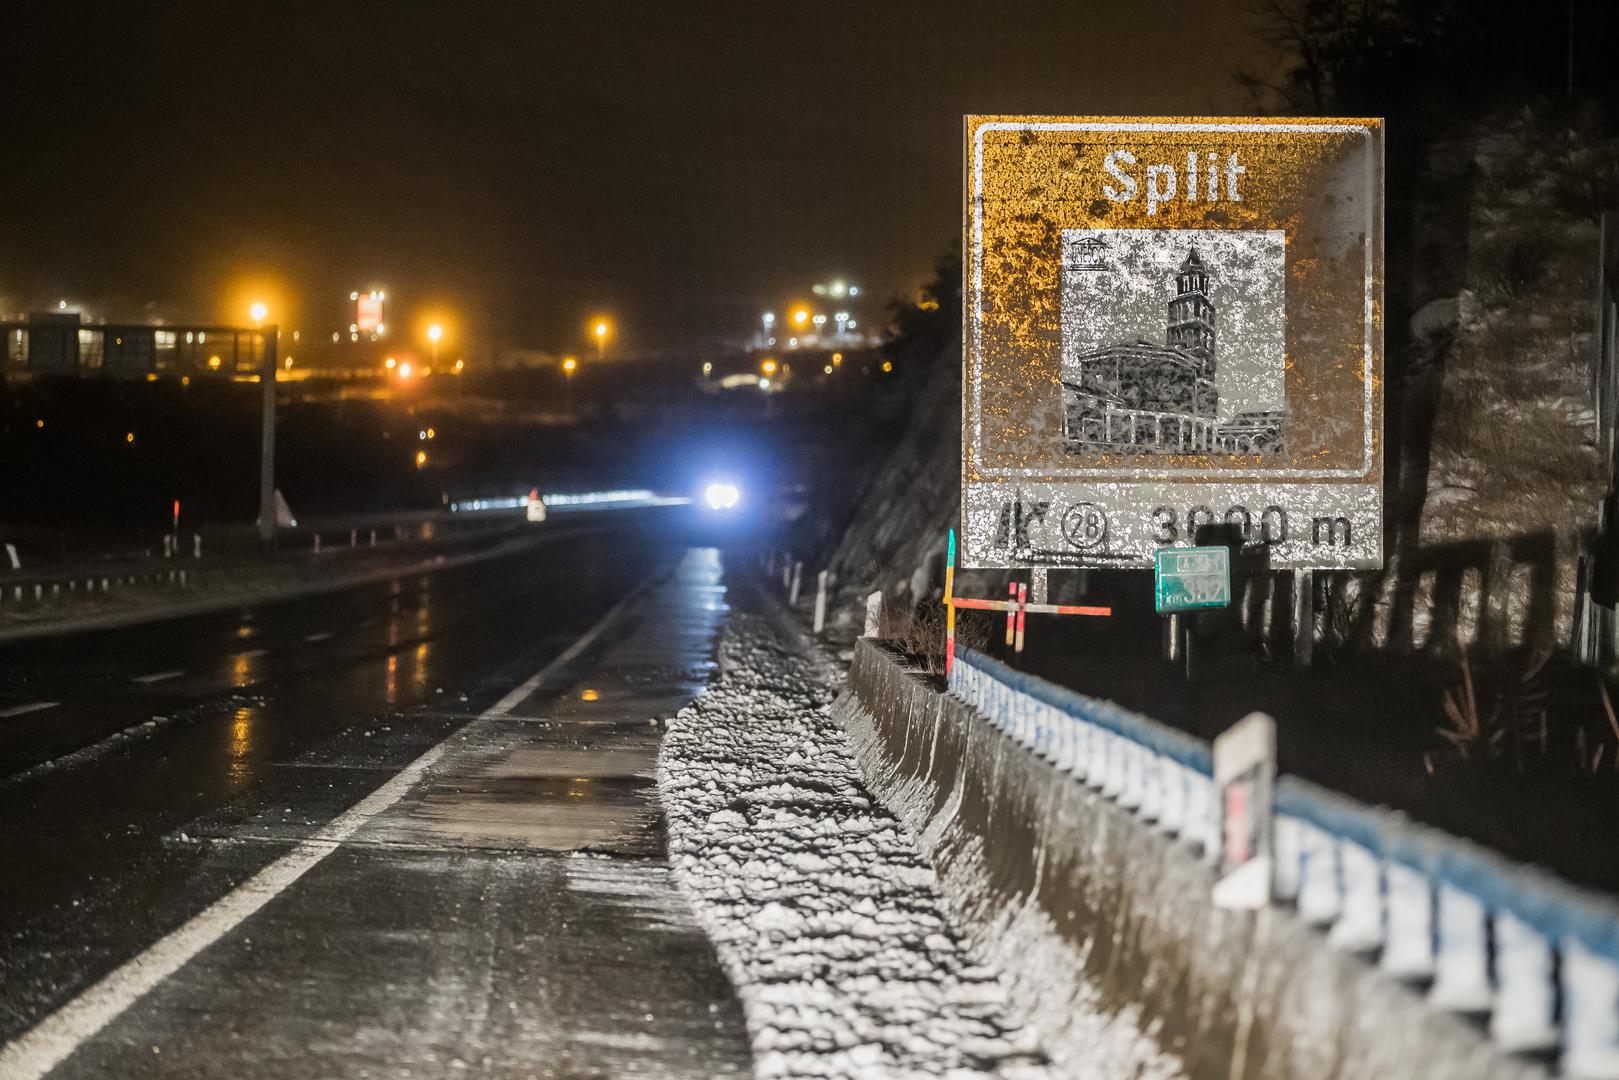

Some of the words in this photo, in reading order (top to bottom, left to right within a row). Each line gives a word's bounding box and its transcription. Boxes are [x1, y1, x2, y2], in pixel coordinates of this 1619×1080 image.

[1103, 150, 1246, 215] Split
[1070, 513, 1099, 539] 28
[1152, 504, 1288, 545] 3000
[1312, 516, 1352, 545] m
